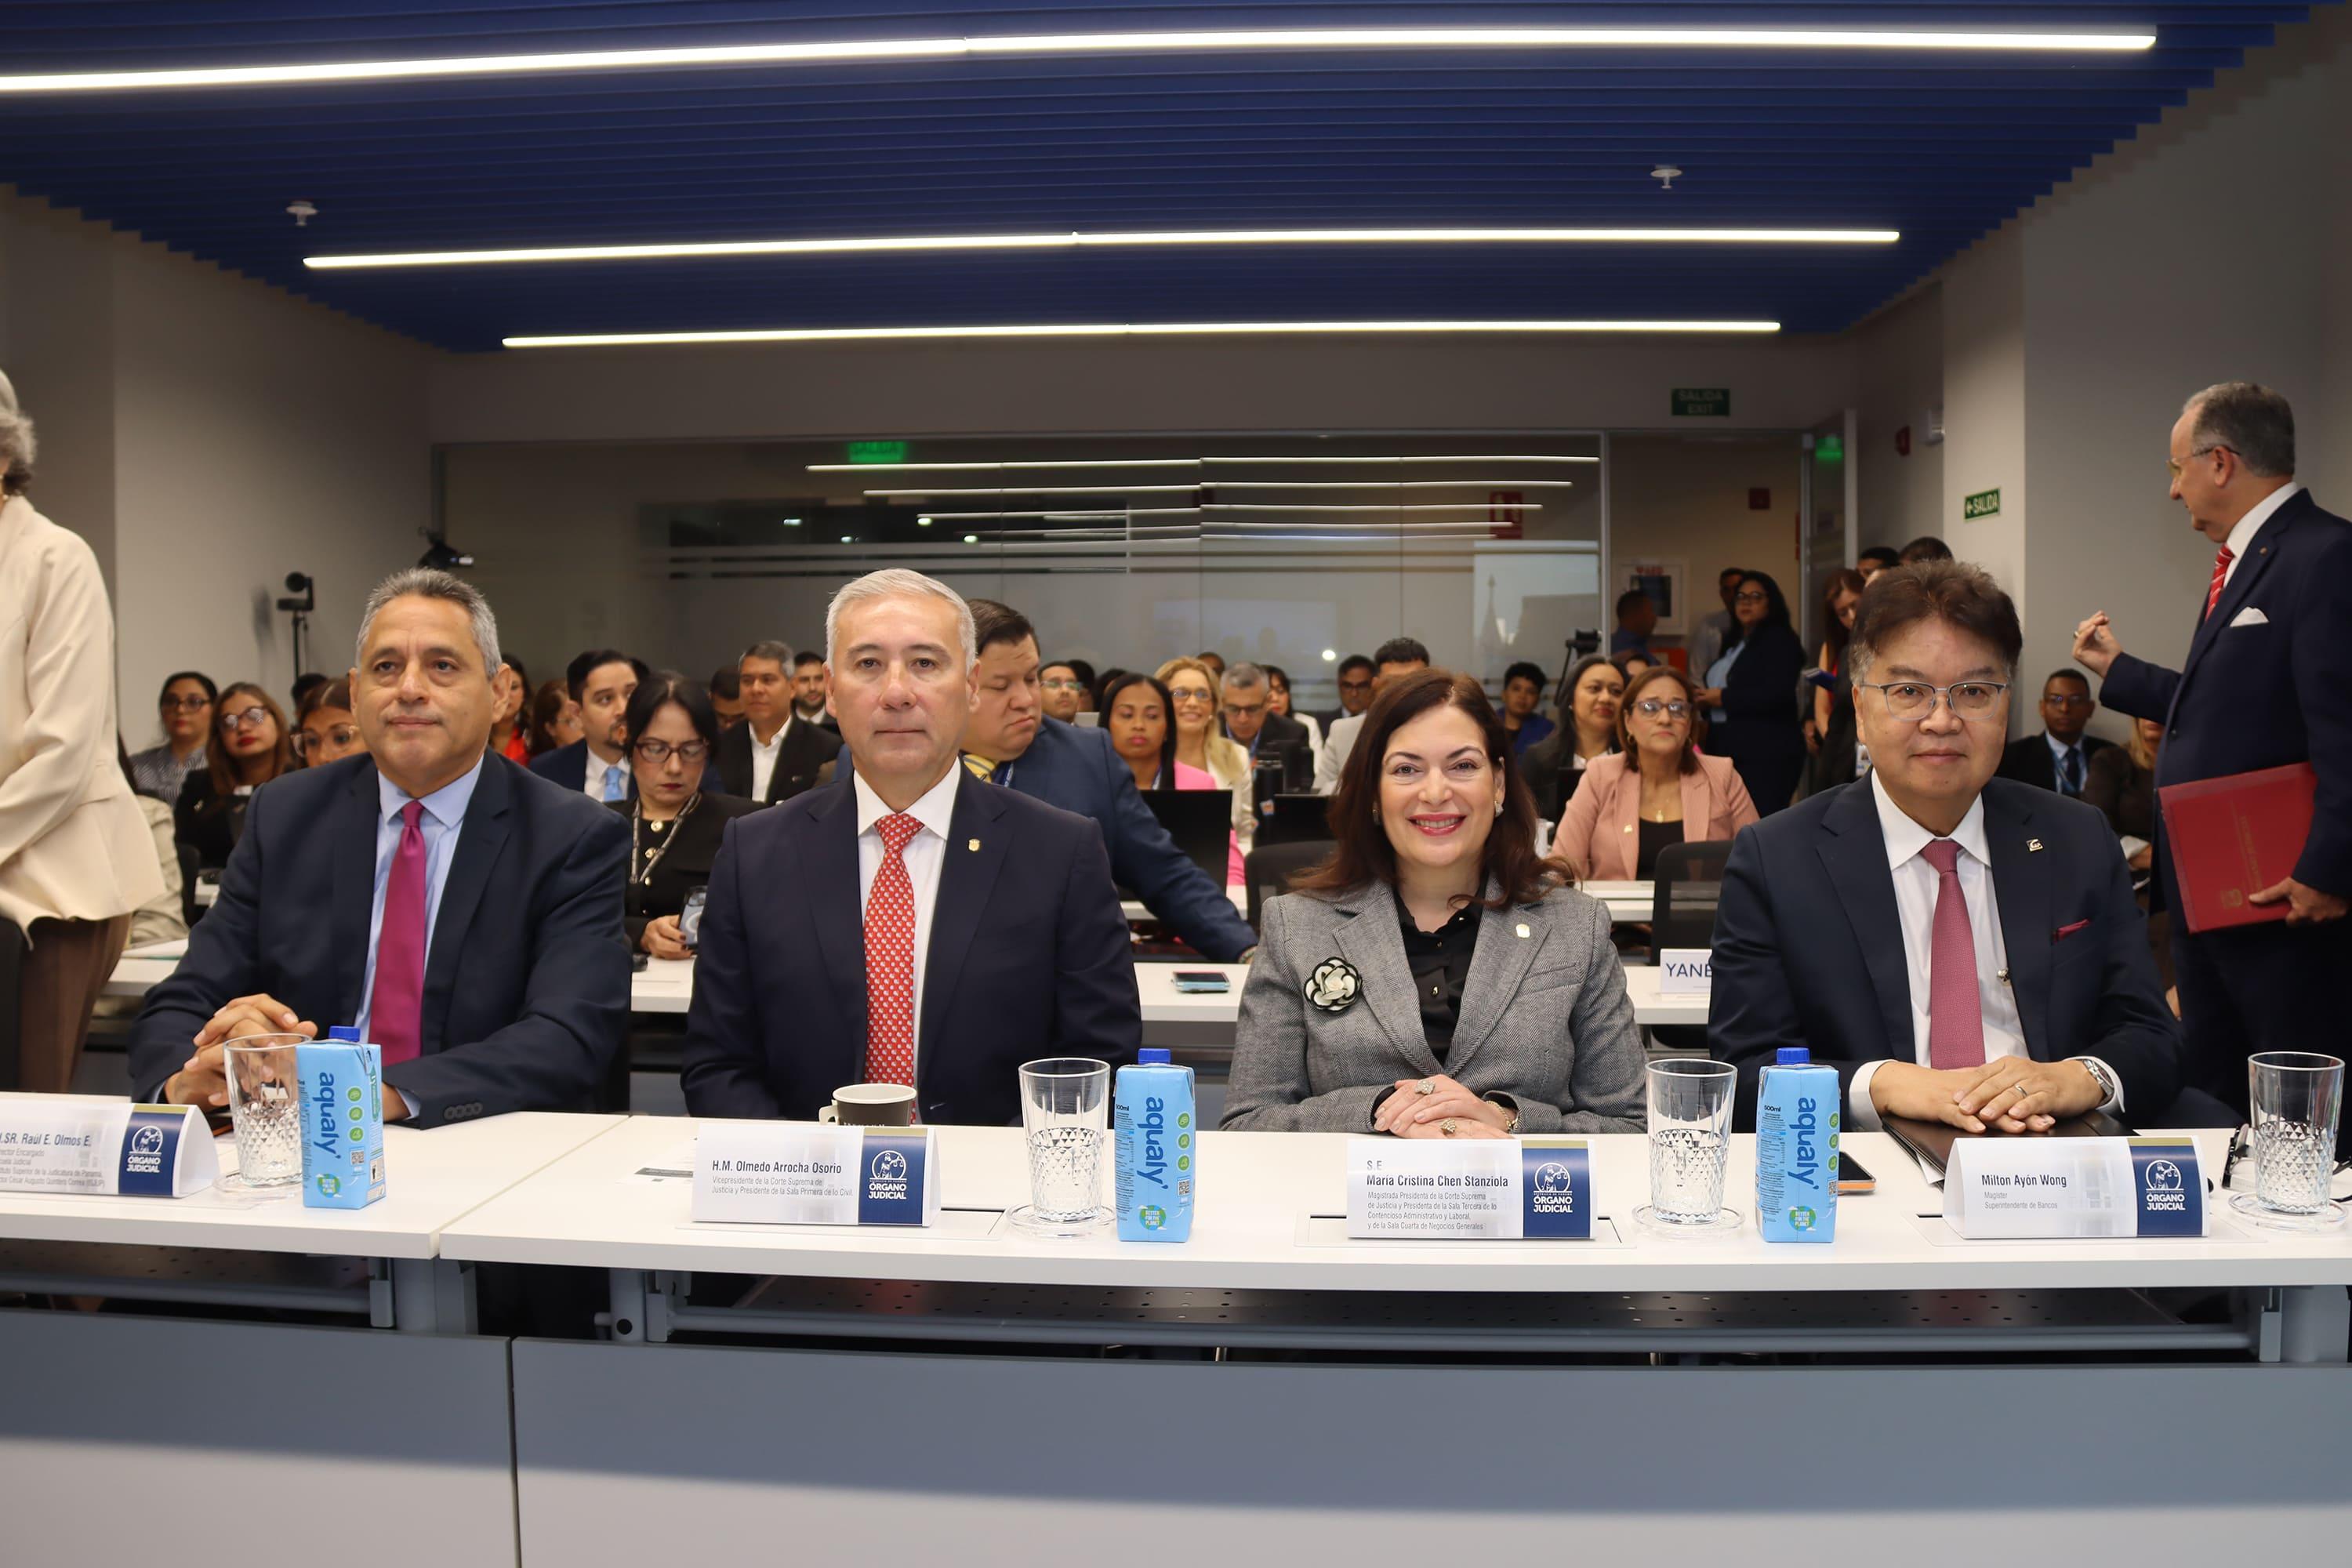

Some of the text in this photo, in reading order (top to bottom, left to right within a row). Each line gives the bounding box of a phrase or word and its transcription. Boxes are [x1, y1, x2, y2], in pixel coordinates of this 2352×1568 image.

[1687, 404, 1713, 414] EXIT
[312, 1072, 339, 1155] aqualy
[21, 1133, 42, 1145] Raúl
[43, 1134, 51, 1145] E.
[54, 1134, 82, 1146] Olmos
[84, 1135, 92, 1146] E.
[1136, 1097, 1168, 1185] aqualy
[1788, 1098, 1819, 1185] aqualy
[126, 1164, 160, 1173] JUDICIAL
[712, 1160, 841, 1174] H.M. Olmedo Arrocha Osorio
[713, 1177, 753, 1185] Vicepresidente
[787, 1178, 814, 1187] Suprema
[1367, 1174, 1508, 1187] María Cristina Chen Stanziola
[1981, 1174, 2067, 1188] Milton Ayón Wong
[869, 1182, 906, 1191] ÓRGANO
[1367, 1192, 1399, 1200] Magistrada
[1461, 1192, 1486, 1201] Suprema
[1534, 1195, 1573, 1204] ÓRGANO
[2146, 1192, 2185, 1202] ÓRGANO
[1429, 1222, 1455, 1231] Negocios
